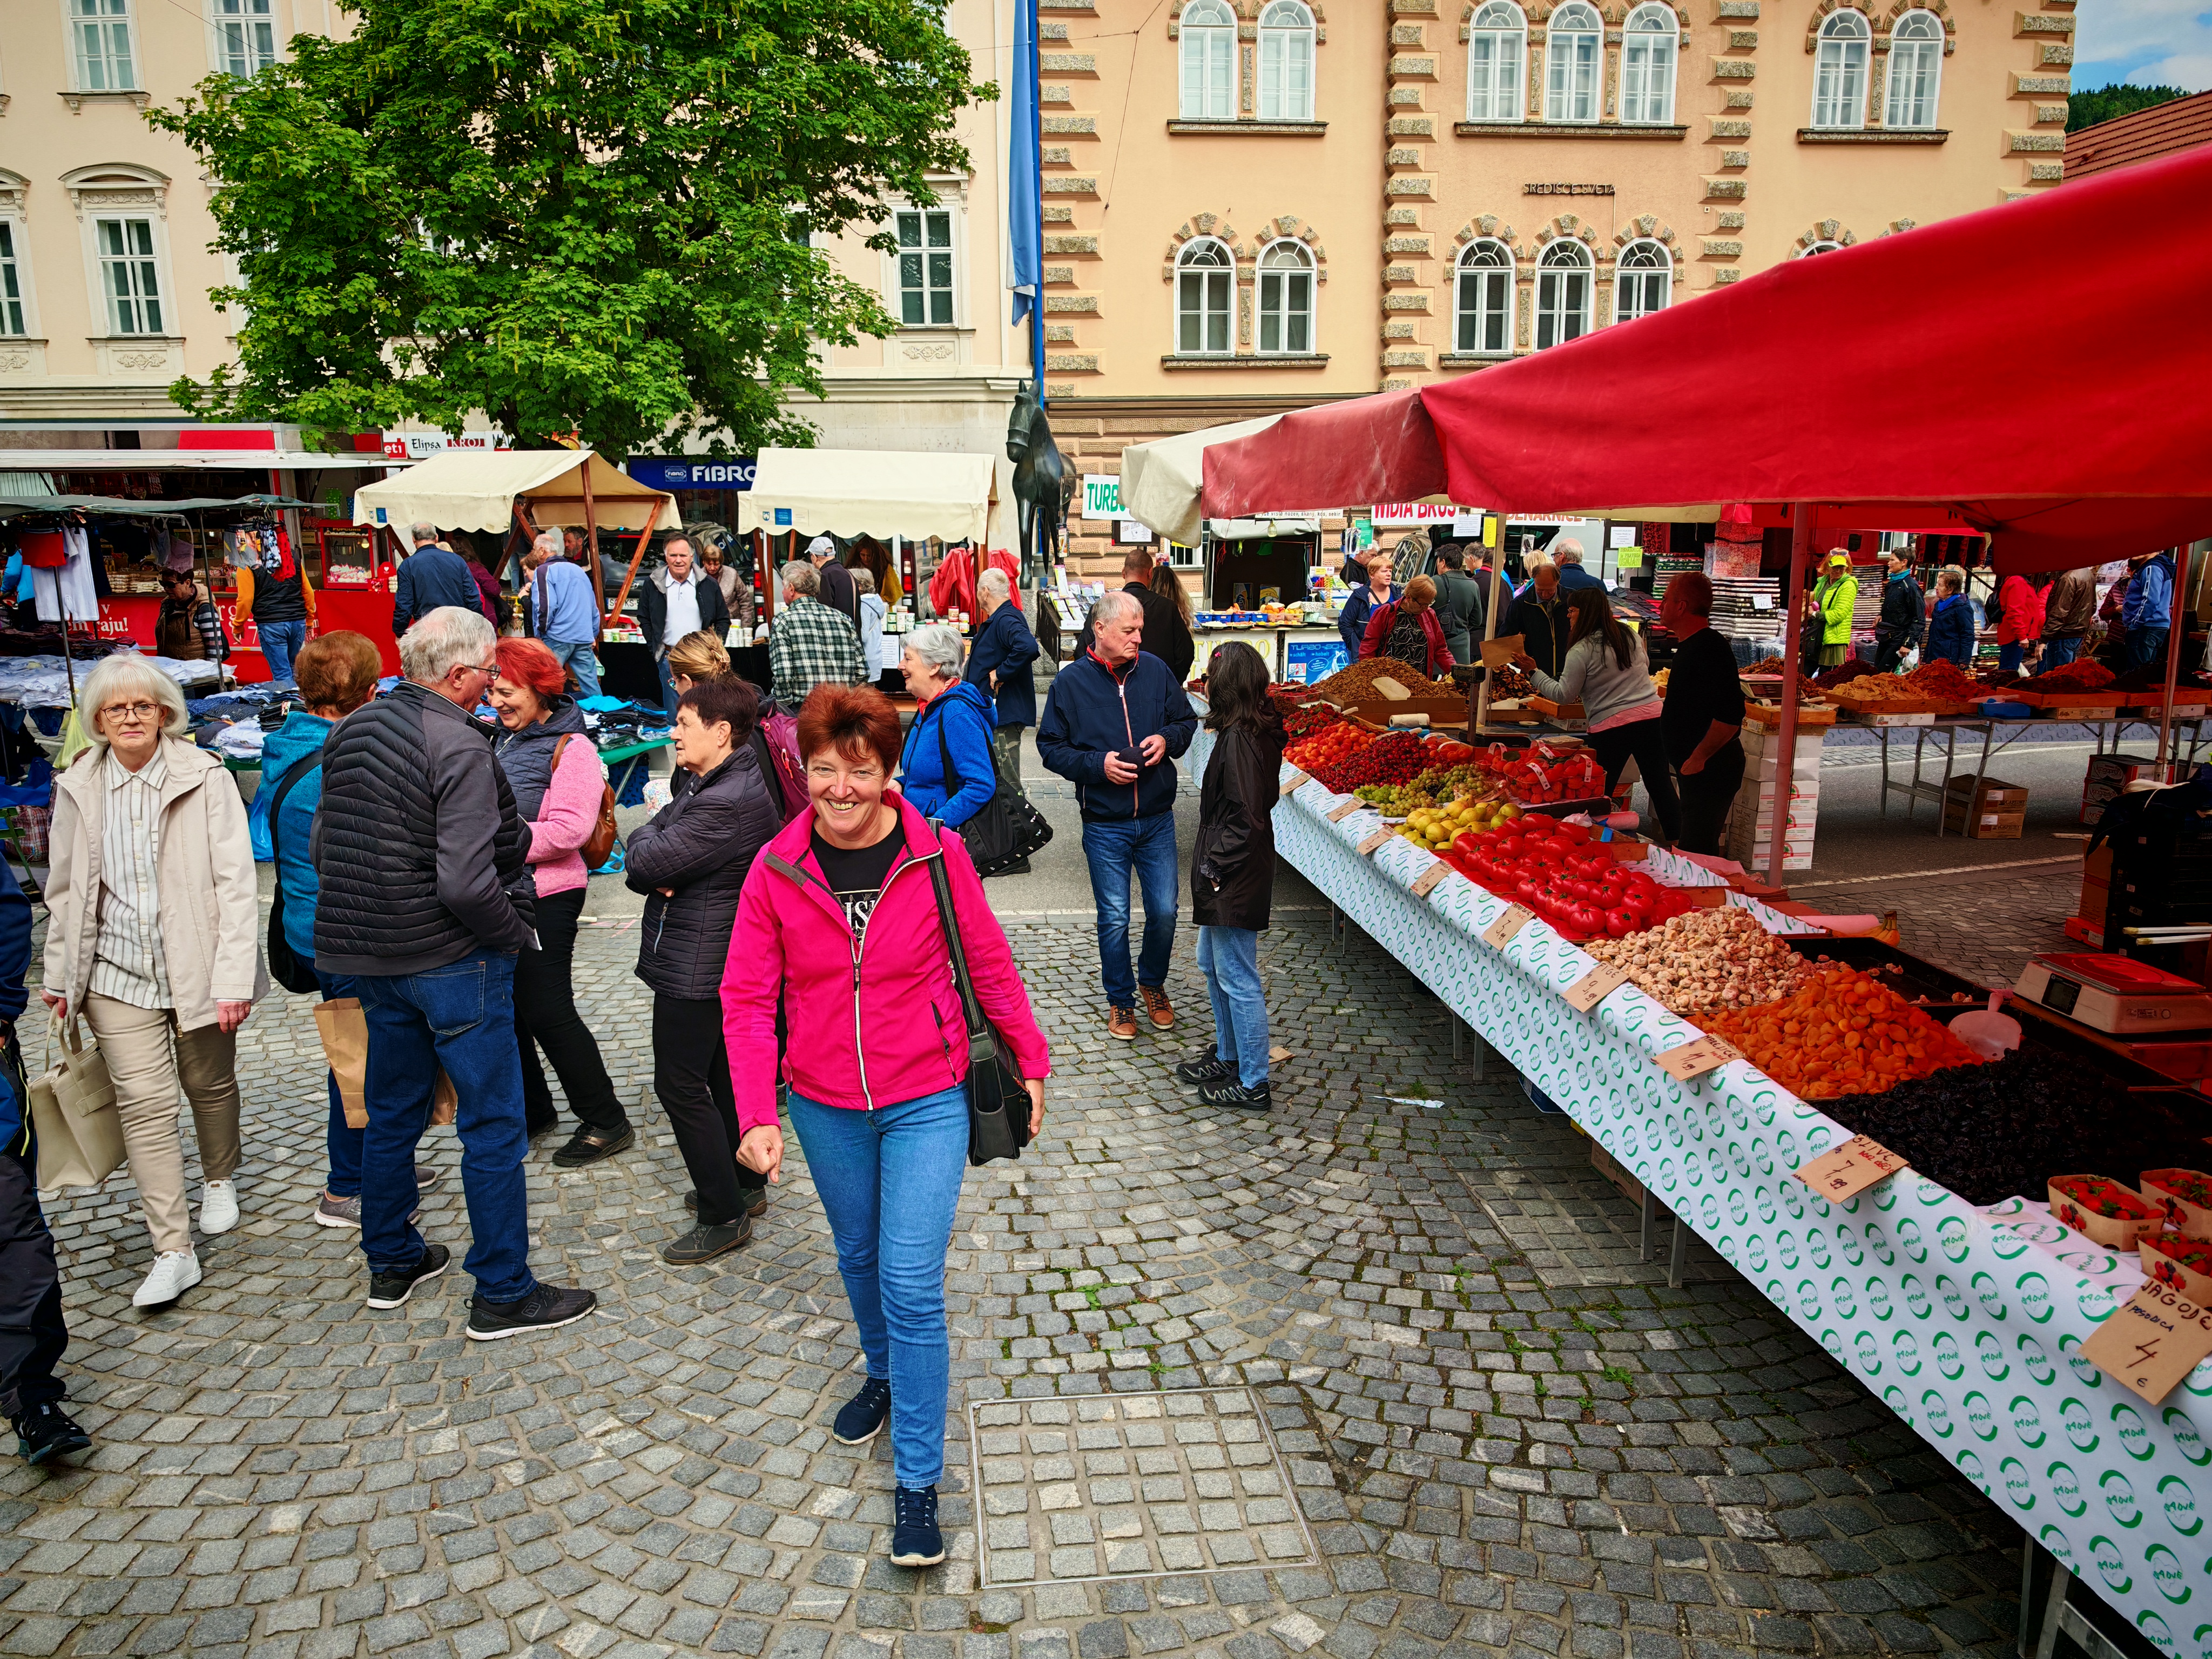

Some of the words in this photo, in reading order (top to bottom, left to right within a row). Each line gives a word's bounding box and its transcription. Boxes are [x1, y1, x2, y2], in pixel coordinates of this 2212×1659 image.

[1522, 181, 1577, 194] SREDIŠČE
[1582, 183, 1616, 194] SVETA
[412, 438, 441, 451] Elipsa
[452, 438, 482, 447] KROJ
[1087, 483, 1126, 512] TURB
[1596, 963, 1620, 978] FIGE
[1703, 1034, 1737, 1058] MARELICE
[1852, 1137, 1894, 1162] SLIVE
[2141, 1280, 2212, 1330] JAGODE
[2127, 1305, 2175, 1332] POSODICA
[2126, 1338, 2161, 1368] 4
